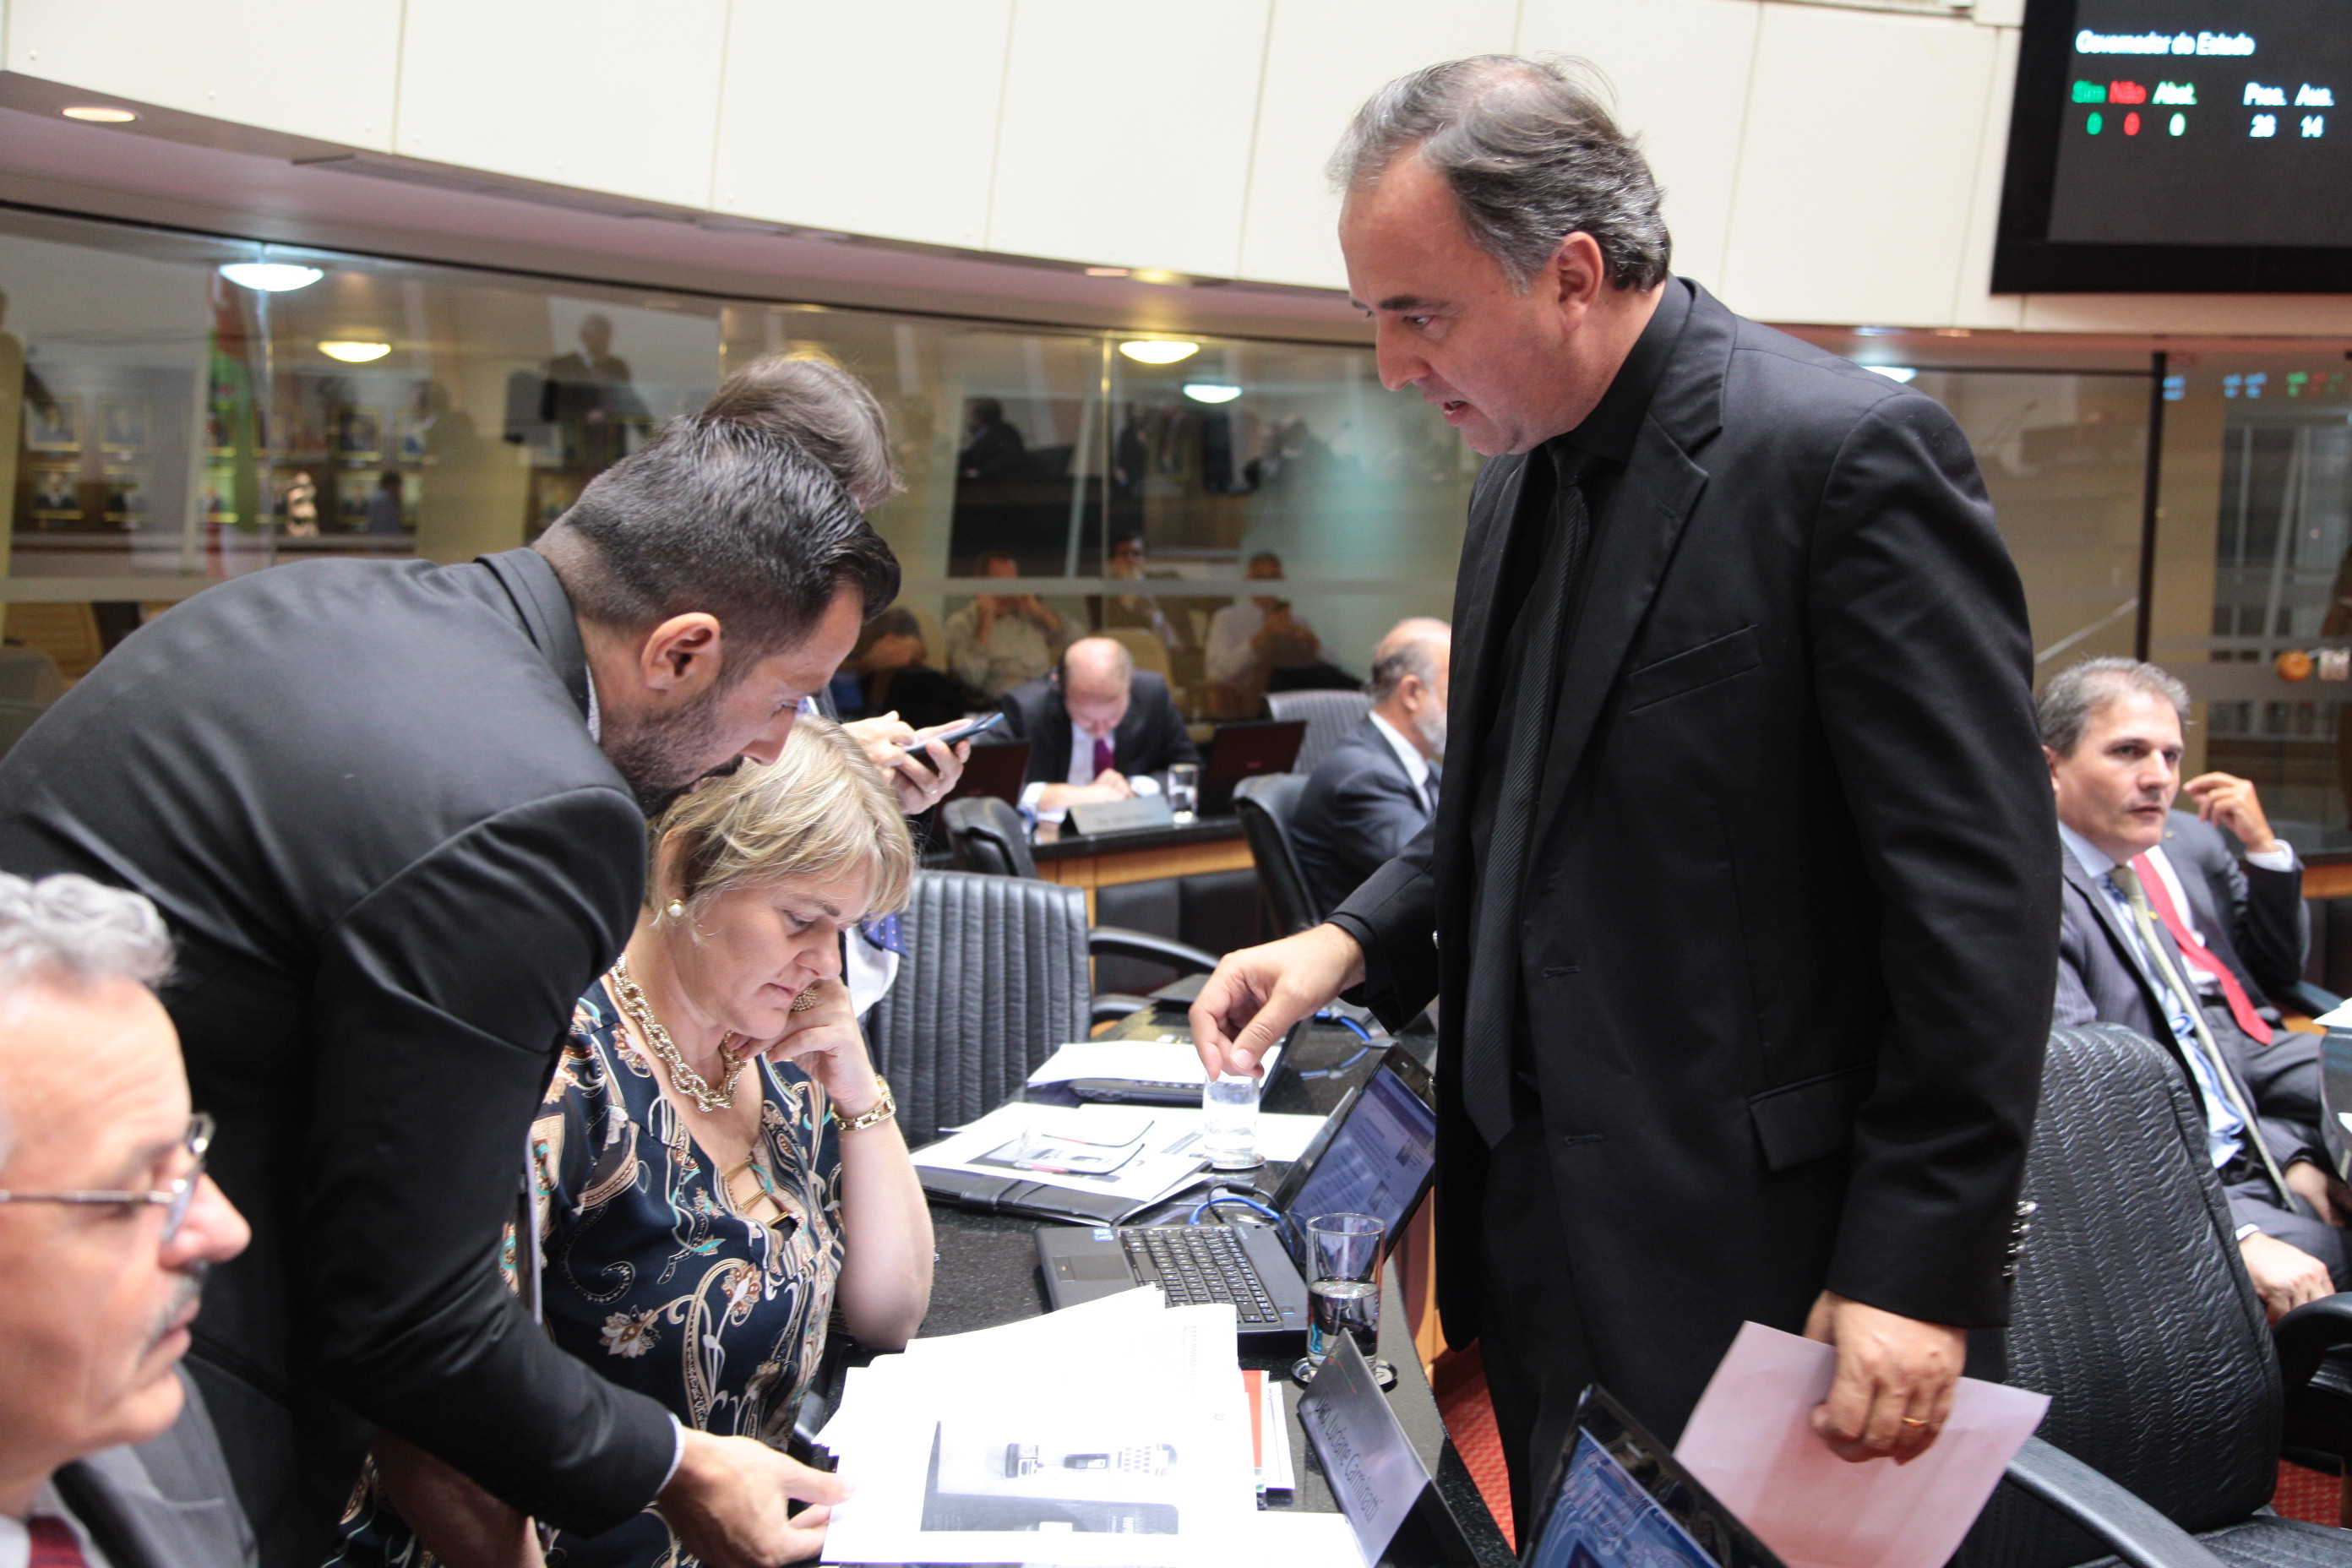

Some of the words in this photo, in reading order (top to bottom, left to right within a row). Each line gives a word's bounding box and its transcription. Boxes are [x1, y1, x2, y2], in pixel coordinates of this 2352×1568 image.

[2171, 31, 2196, 55] do
[2086, 112, 2103, 135] 0
[2124, 112, 2140, 135] 0
[2169, 112, 2186, 137] 0
[2300, 114, 2324, 138] 14
[1326, 1413, 1352, 1466] Luciane
